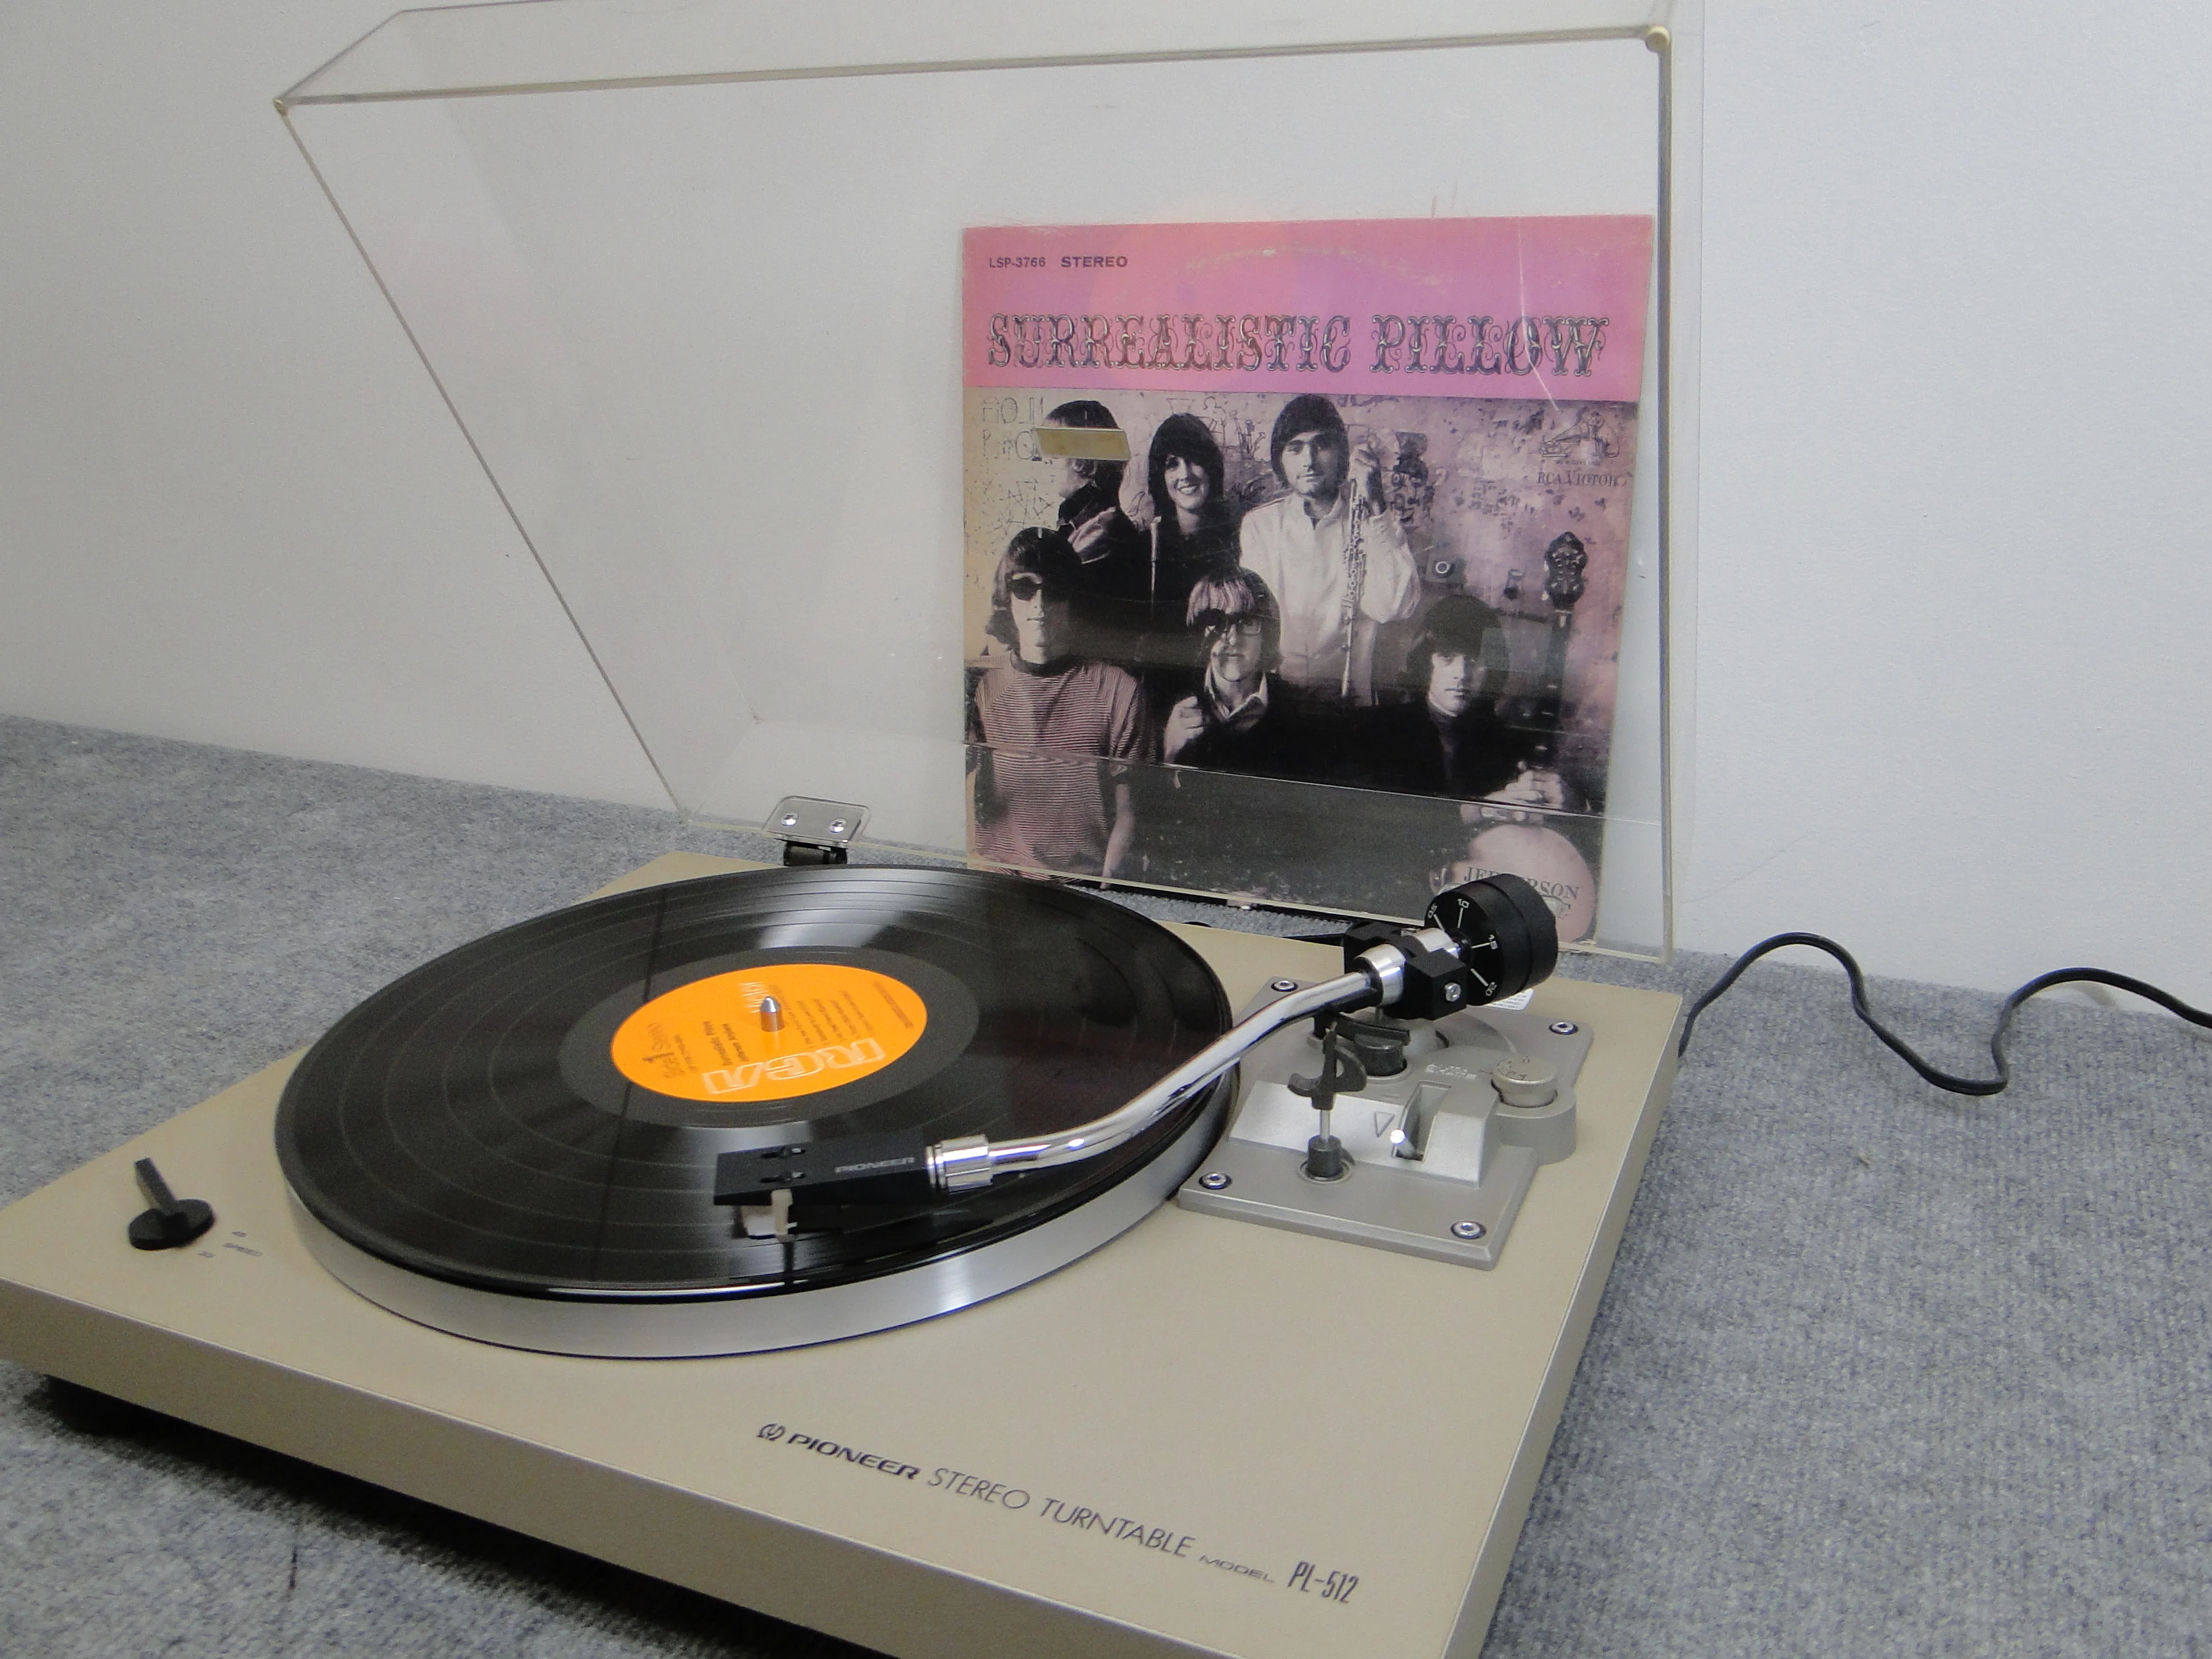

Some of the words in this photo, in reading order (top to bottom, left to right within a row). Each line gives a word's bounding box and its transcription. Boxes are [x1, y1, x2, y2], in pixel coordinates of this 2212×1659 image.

[989, 257, 1046, 269] LSP-3766
[1060, 256, 1128, 268] STEREO
[987, 313, 1350, 374] SURREALISTIC
[1369, 315, 1609, 378] PILLOW
[1537, 471, 1562, 485] RCA
[703, 1038, 886, 1094] RCA
[787, 1433, 922, 1480] PIONEER
[927, 1468, 1030, 1509] STEREO
[1040, 1498, 1196, 1558] TURNTABLE
[1199, 1554, 1276, 1583] MODEL
[1287, 1560, 1360, 1604] PL-512
